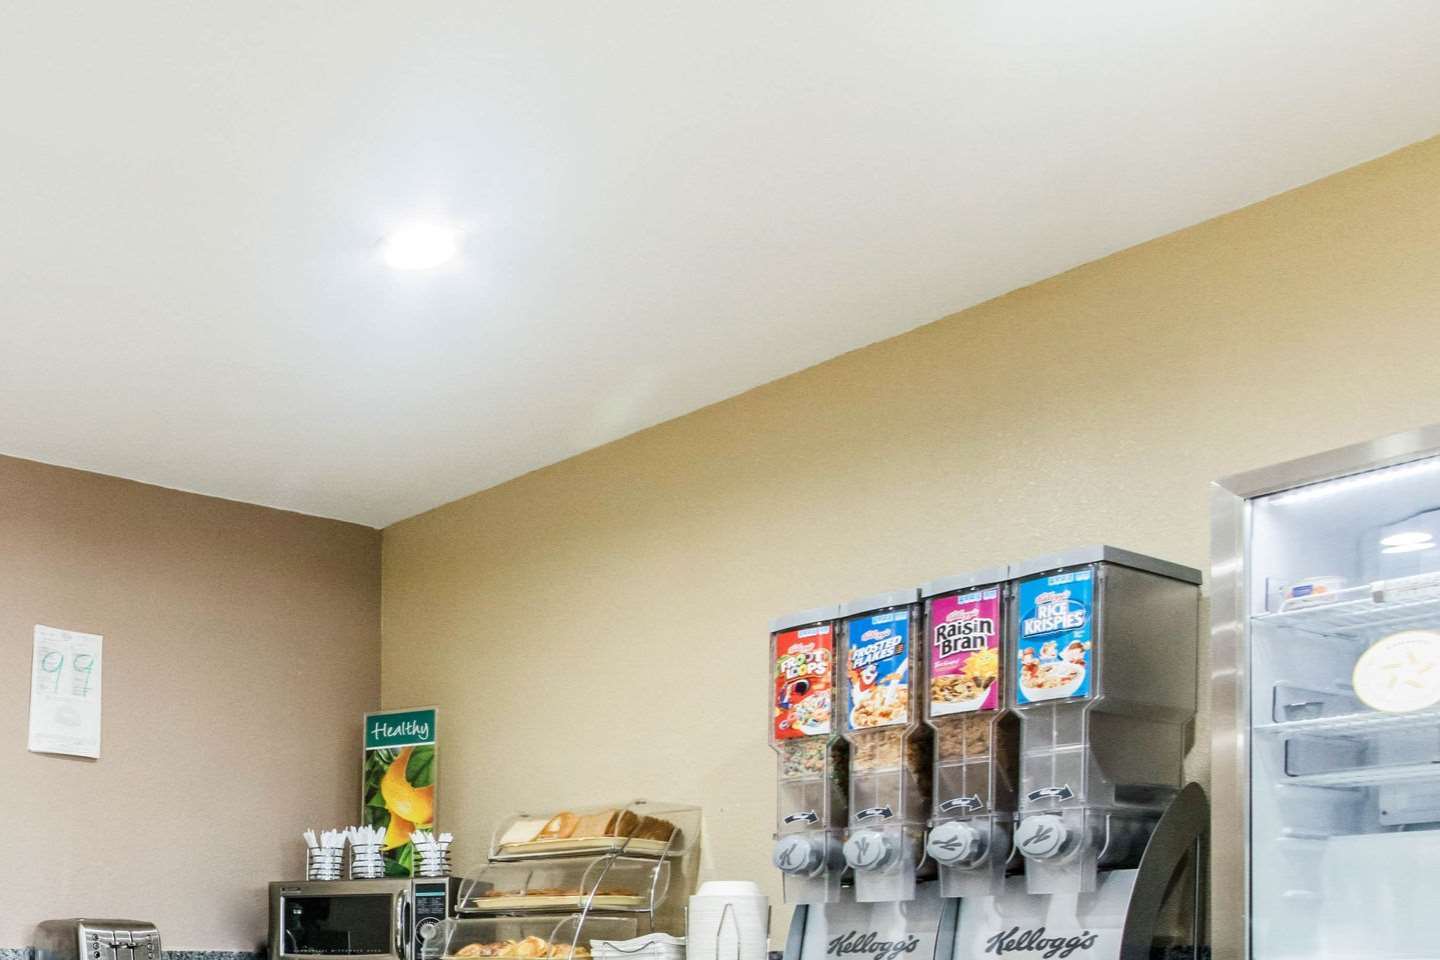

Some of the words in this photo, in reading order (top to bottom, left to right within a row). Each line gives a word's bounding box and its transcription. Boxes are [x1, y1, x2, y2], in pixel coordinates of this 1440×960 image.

[1037, 600, 1070, 618] RICE
[935, 618, 993, 644] Raisin
[1023, 610, 1086, 636] KRISPIES
[852, 635, 902, 660] FROSTED
[941, 635, 985, 656] Bran
[853, 648, 895, 670] FLAKES
[371, 720, 429, 740] Healthy
[827, 930, 920, 960] Kellogg's
[985, 926, 1098, 960] Kellogg's
